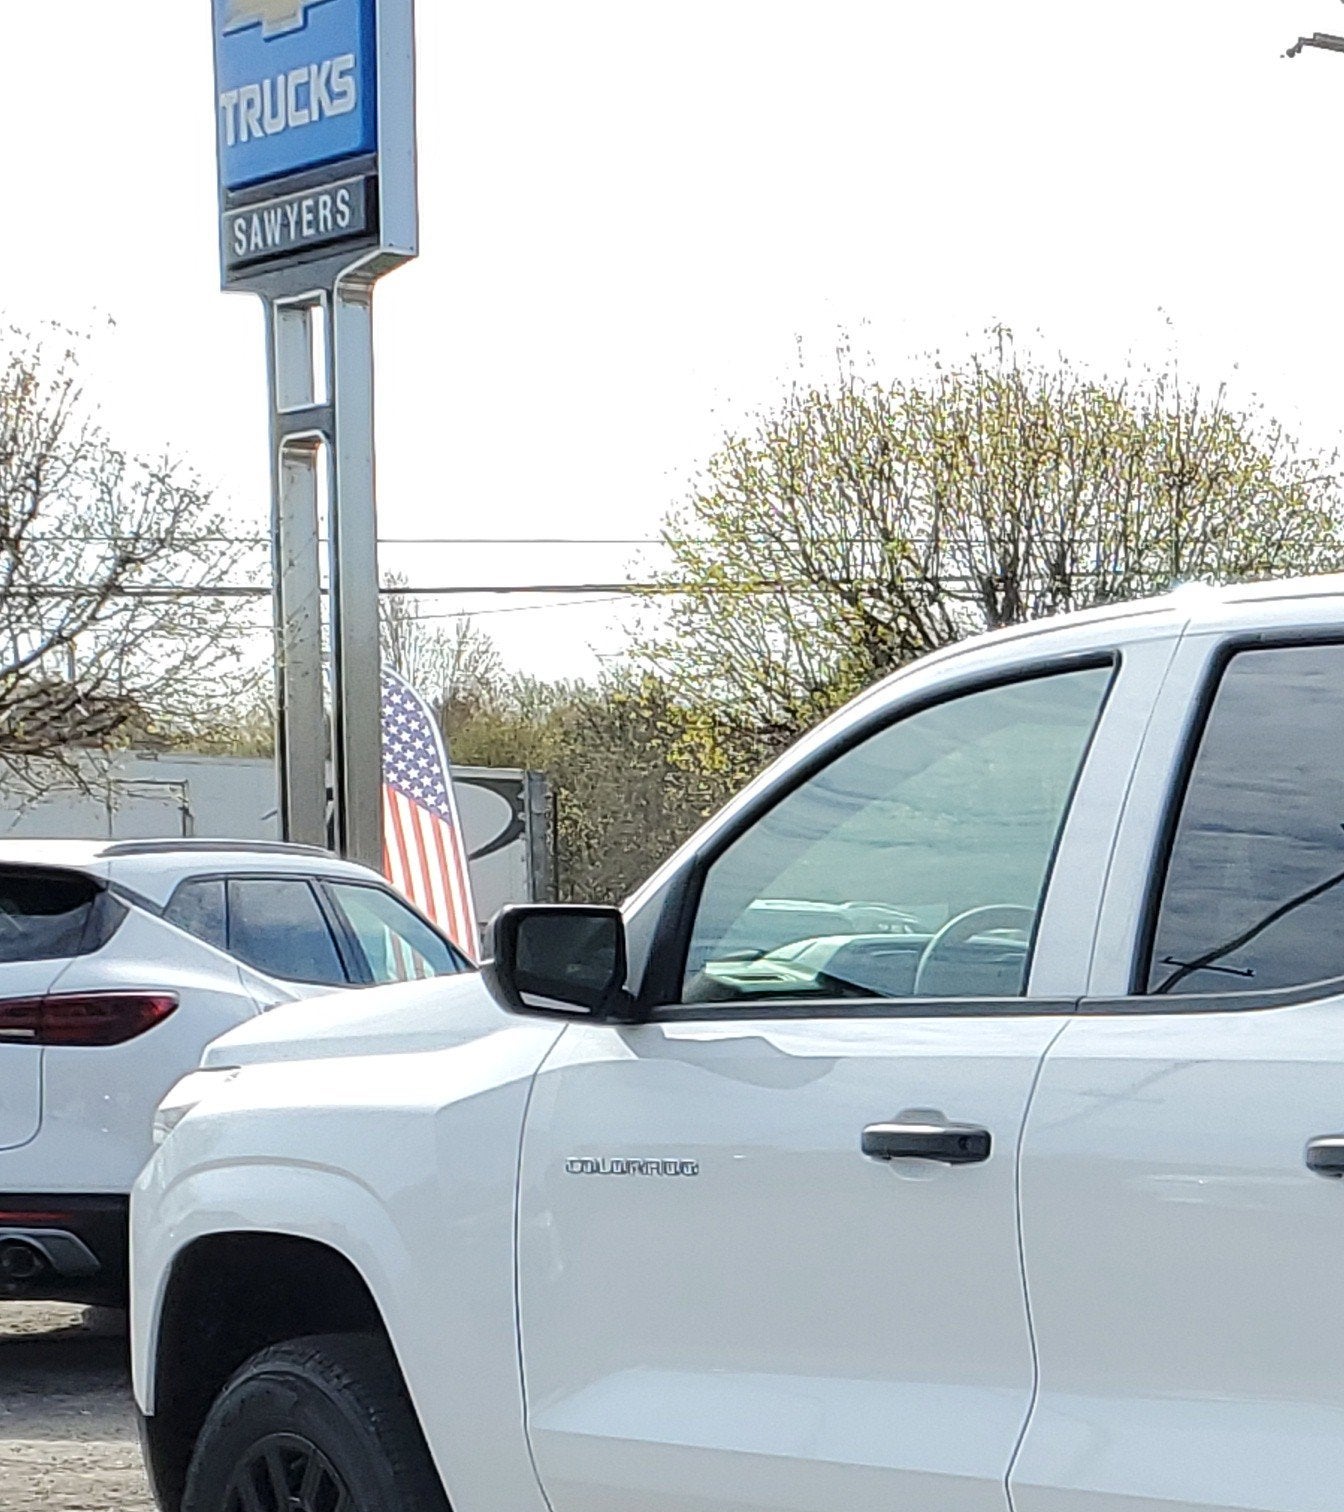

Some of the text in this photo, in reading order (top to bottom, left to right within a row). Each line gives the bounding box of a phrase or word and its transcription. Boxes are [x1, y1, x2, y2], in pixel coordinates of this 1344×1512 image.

[219, 53, 356, 146] TRUCKS
[234, 188, 350, 256] SAWYERS
[565, 1156, 699, 1176] COLORADO
